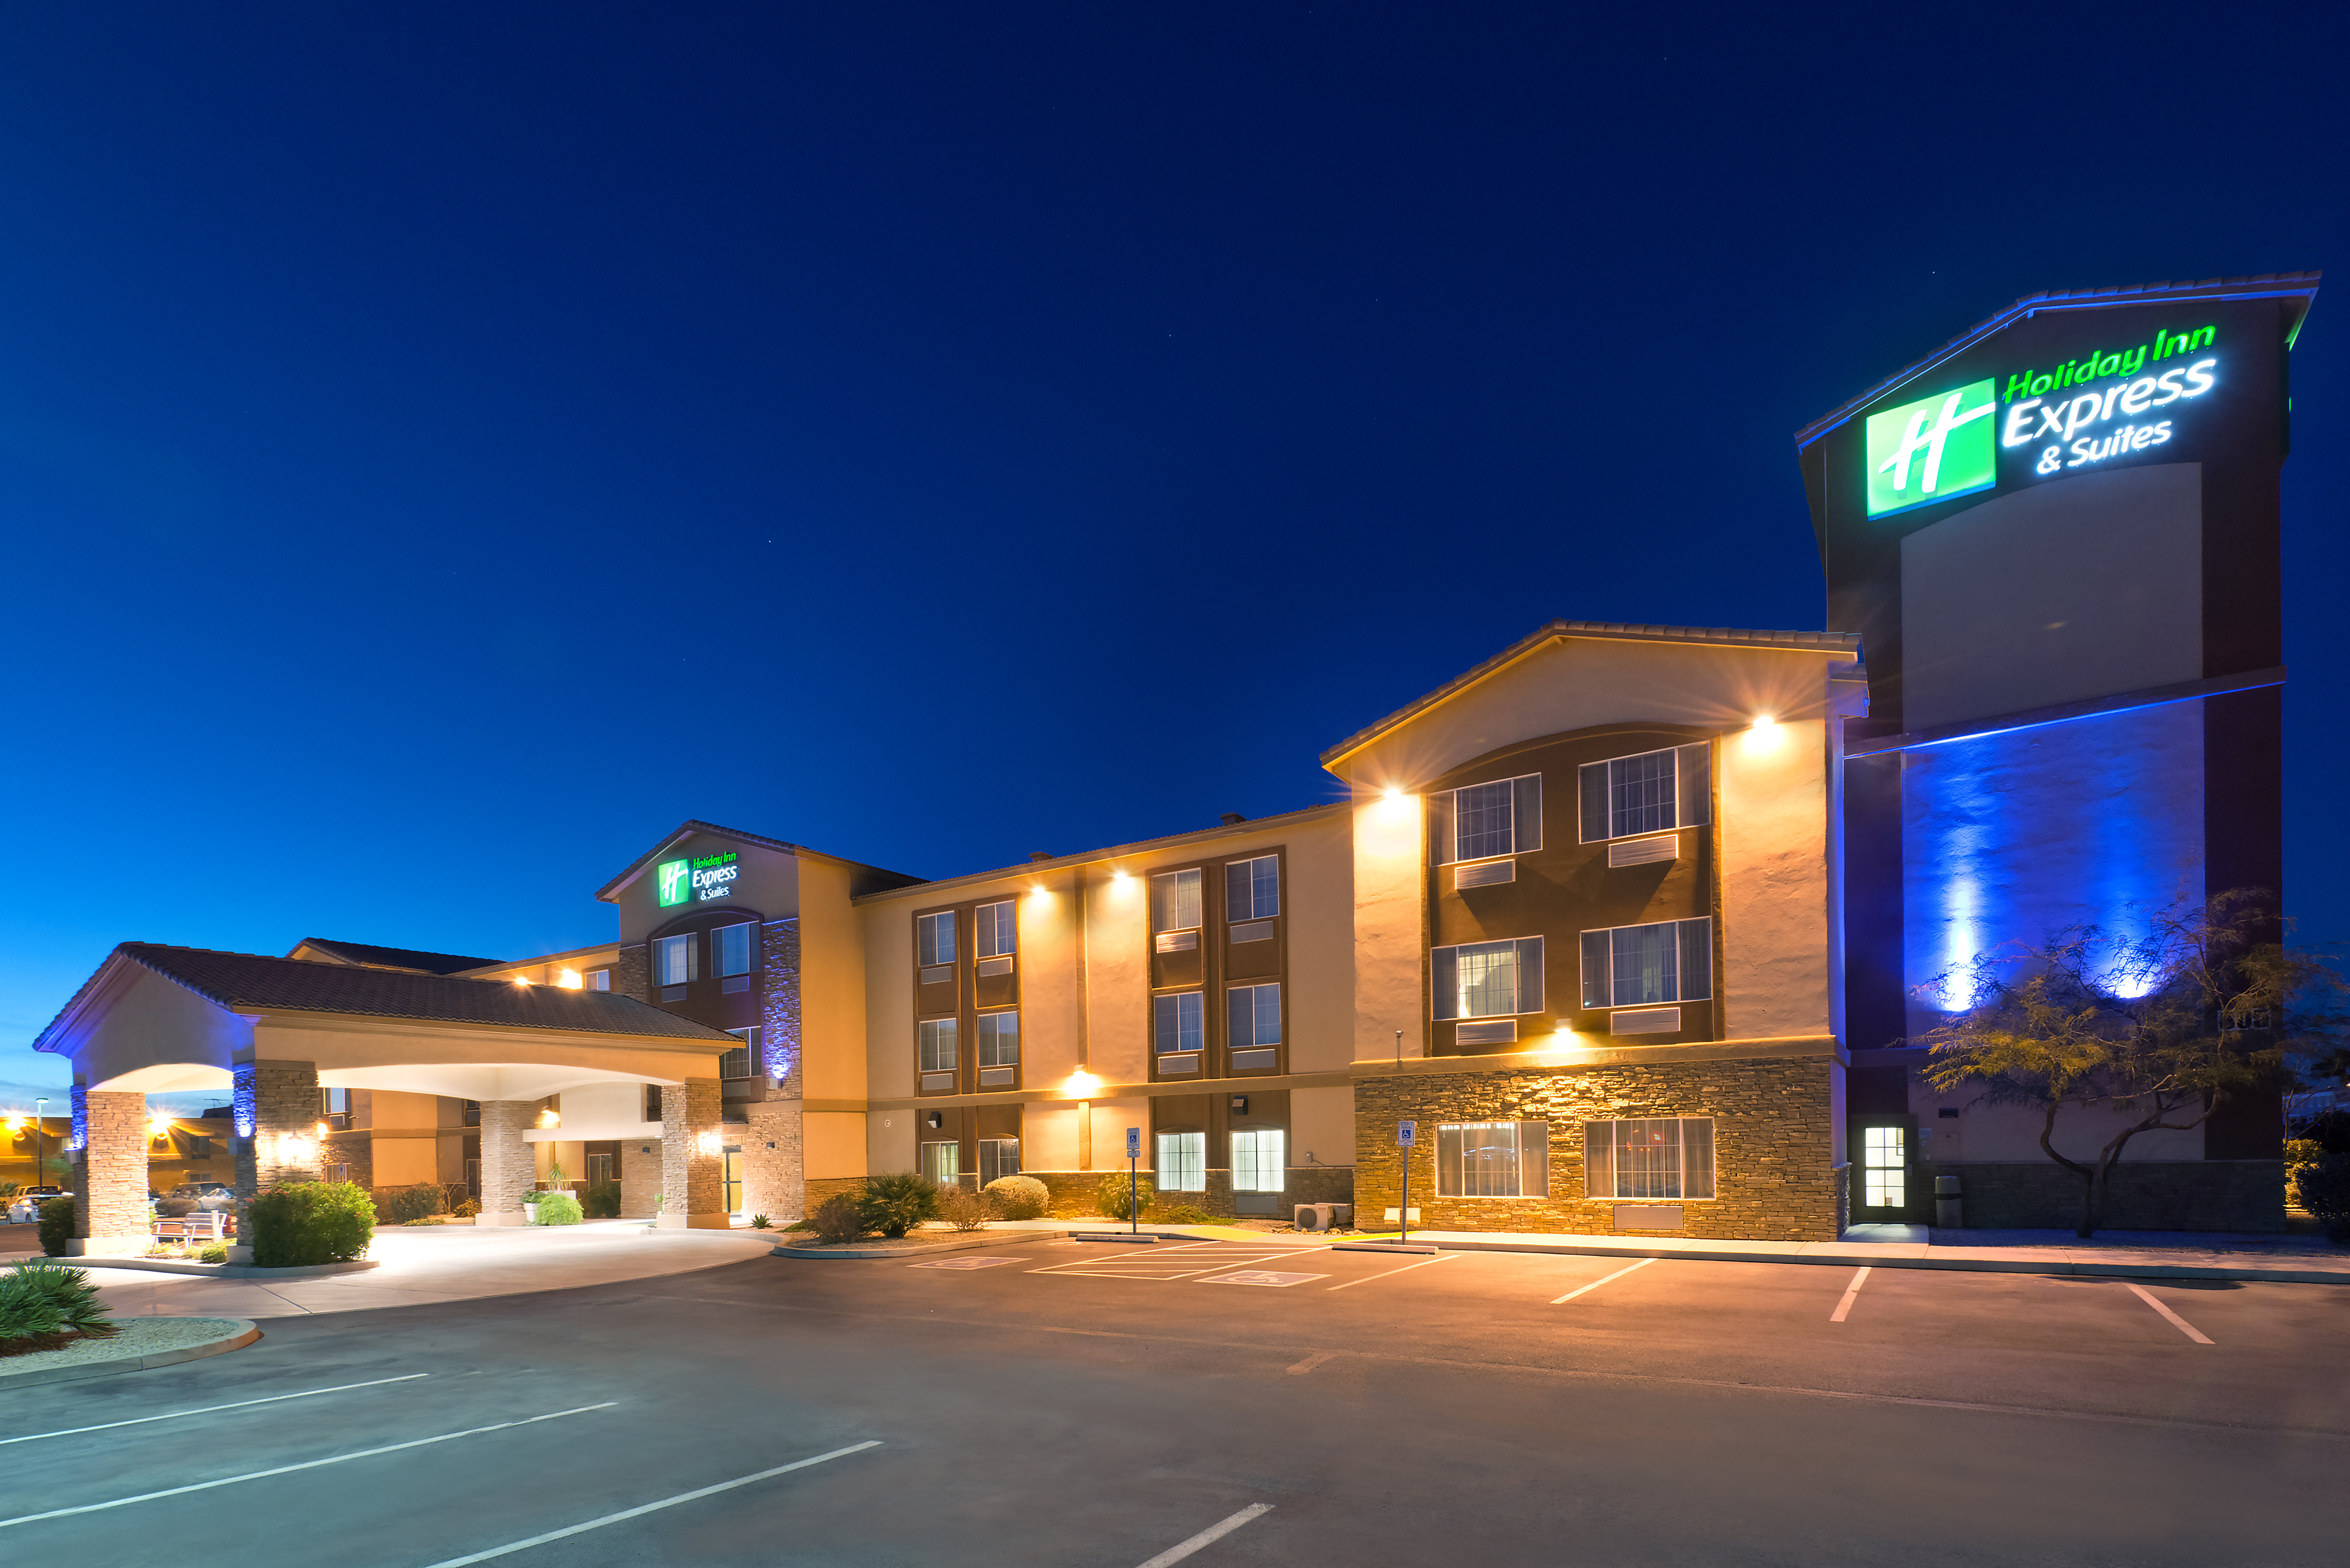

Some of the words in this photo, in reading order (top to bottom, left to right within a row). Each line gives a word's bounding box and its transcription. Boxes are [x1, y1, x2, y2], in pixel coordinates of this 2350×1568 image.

[2003, 345, 2147, 403] Holiday
[2152, 326, 2216, 361] Inn
[2003, 359, 2216, 447] Express
[2037, 446, 2061, 474] &
[2067, 421, 2172, 466] Suites
[692, 866, 737, 888] Express
[693, 855, 723, 869] Holiday
[723, 851, 736, 863] Inn
[700, 889, 707, 900] &
[707, 886, 729, 900] Suites
